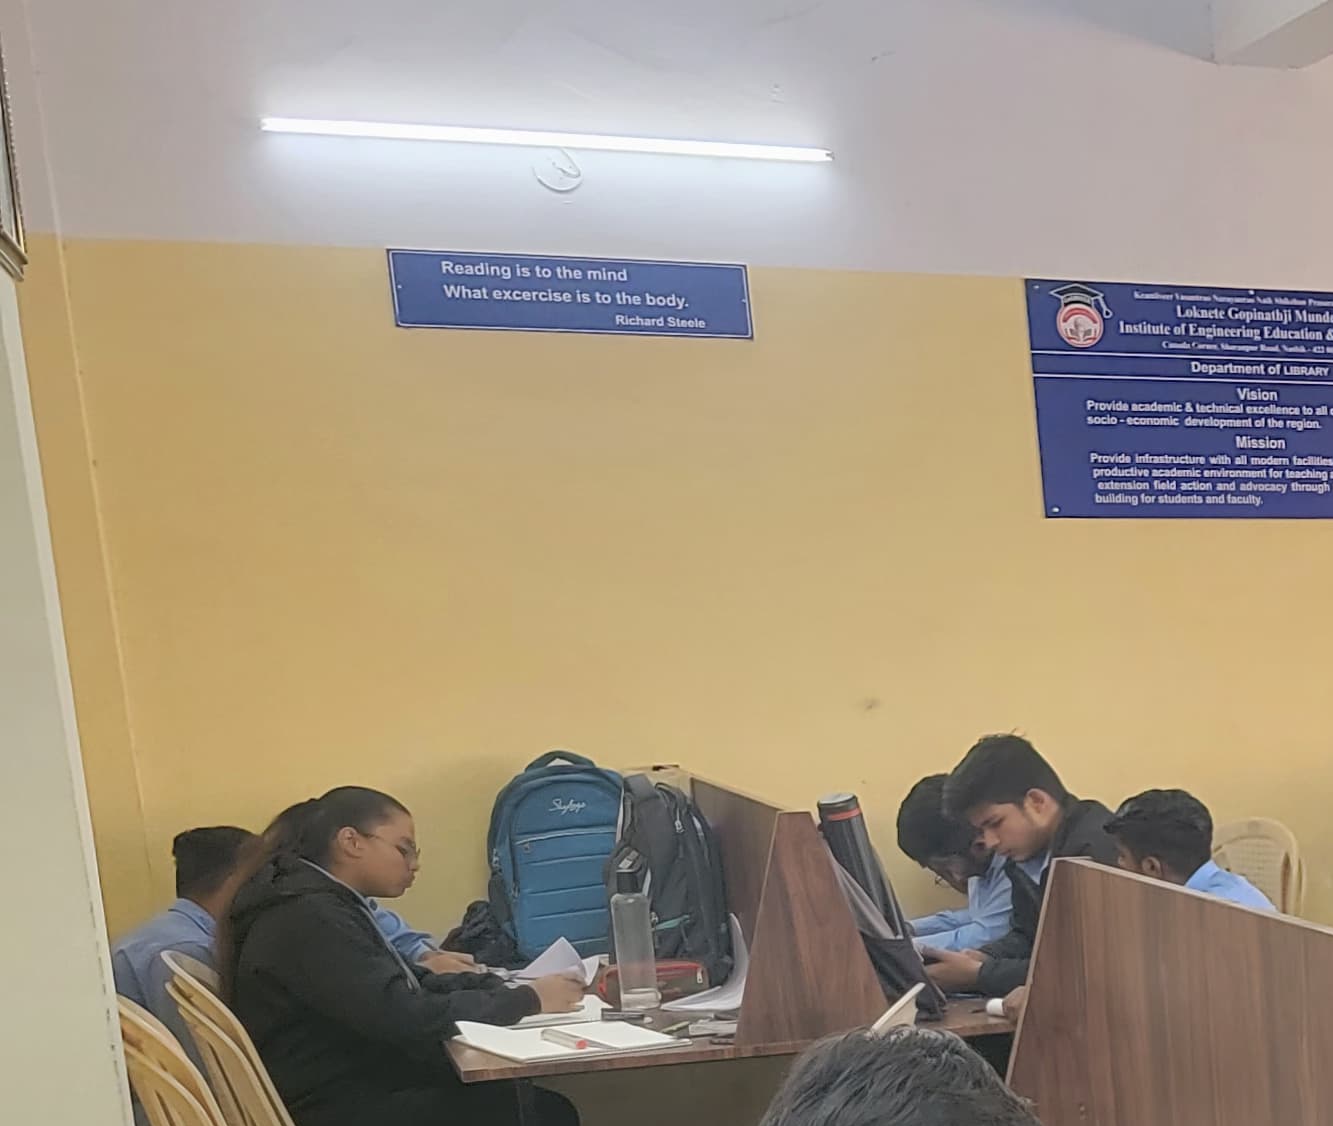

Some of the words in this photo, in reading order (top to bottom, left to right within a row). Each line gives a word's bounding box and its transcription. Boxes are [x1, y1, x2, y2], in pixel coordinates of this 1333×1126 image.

[441, 261, 511, 279] Reading
[516, 264, 530, 277] is
[536, 265, 551, 278] to
[556, 266, 582, 279] the
[587, 268, 627, 281] mind
[443, 284, 488, 299] What
[493, 288, 571, 302] excercise
[576, 290, 591, 303] is
[595, 291, 611, 304] to
[616, 292, 641, 305] the
[646, 293, 689, 309] body.
[616, 314, 664, 326] Richard
[667, 317, 706, 328] Steele
[1176, 305, 1225, 319] Loknete
[1228, 307, 1292, 324] Gopinathji
[1119, 321, 1170, 335] Institute
[1173, 323, 1186, 335] of
[1189, 323, 1261, 341] Engineering
[1263, 326, 1323, 340] Education
[1191, 361, 1264, 375] Department
[1268, 364, 1280, 375] of
[1284, 366, 1329, 376] LIBRARY
[1237, 388, 1277, 401] Vision
[1086, 400, 1129, 411] Provide
[1131, 402, 1183, 412] academic
[1184, 402, 1193, 413] &
[1196, 403, 1243, 413] technical
[1245, 404, 1300, 415] excellence
[1302, 406, 1313, 416] to
[1315, 406, 1328, 416] all
[1086, 414, 1118, 425] socio
[1126, 416, 1179, 426] economic
[1184, 416, 1252, 429] development
[1254, 418, 1265, 427] of
[1267, 418, 1284, 428] the
[1235, 436, 1285, 449] Mission
[1090, 453, 1131, 463] Provide
[1135, 454, 1205, 464] infrastructure
[1209, 455, 1231, 464] with
[1235, 455, 1247, 465] all
[1251, 456, 1289, 465] modern
[1293, 456, 1333, 466] facilities
[1093, 467, 1149, 478] productive
[1152, 468, 1201, 477] academic
[1204, 468, 1266, 478] environment
[1268, 468, 1283, 478] for
[1285, 469, 1328, 480] teaching
[1097, 480, 1149, 490] extension
[1154, 480, 1176, 490] field
[1180, 481, 1212, 490] action
[1215, 481, 1235, 491] and
[1239, 482, 1287, 493] advocacy
[1291, 482, 1330, 494] through
[1095, 493, 1138, 505] building
[1140, 494, 1155, 503] for
[1158, 494, 1203, 504] students
[1205, 494, 1225, 504] and
[1226, 494, 1263, 506] faculty.
